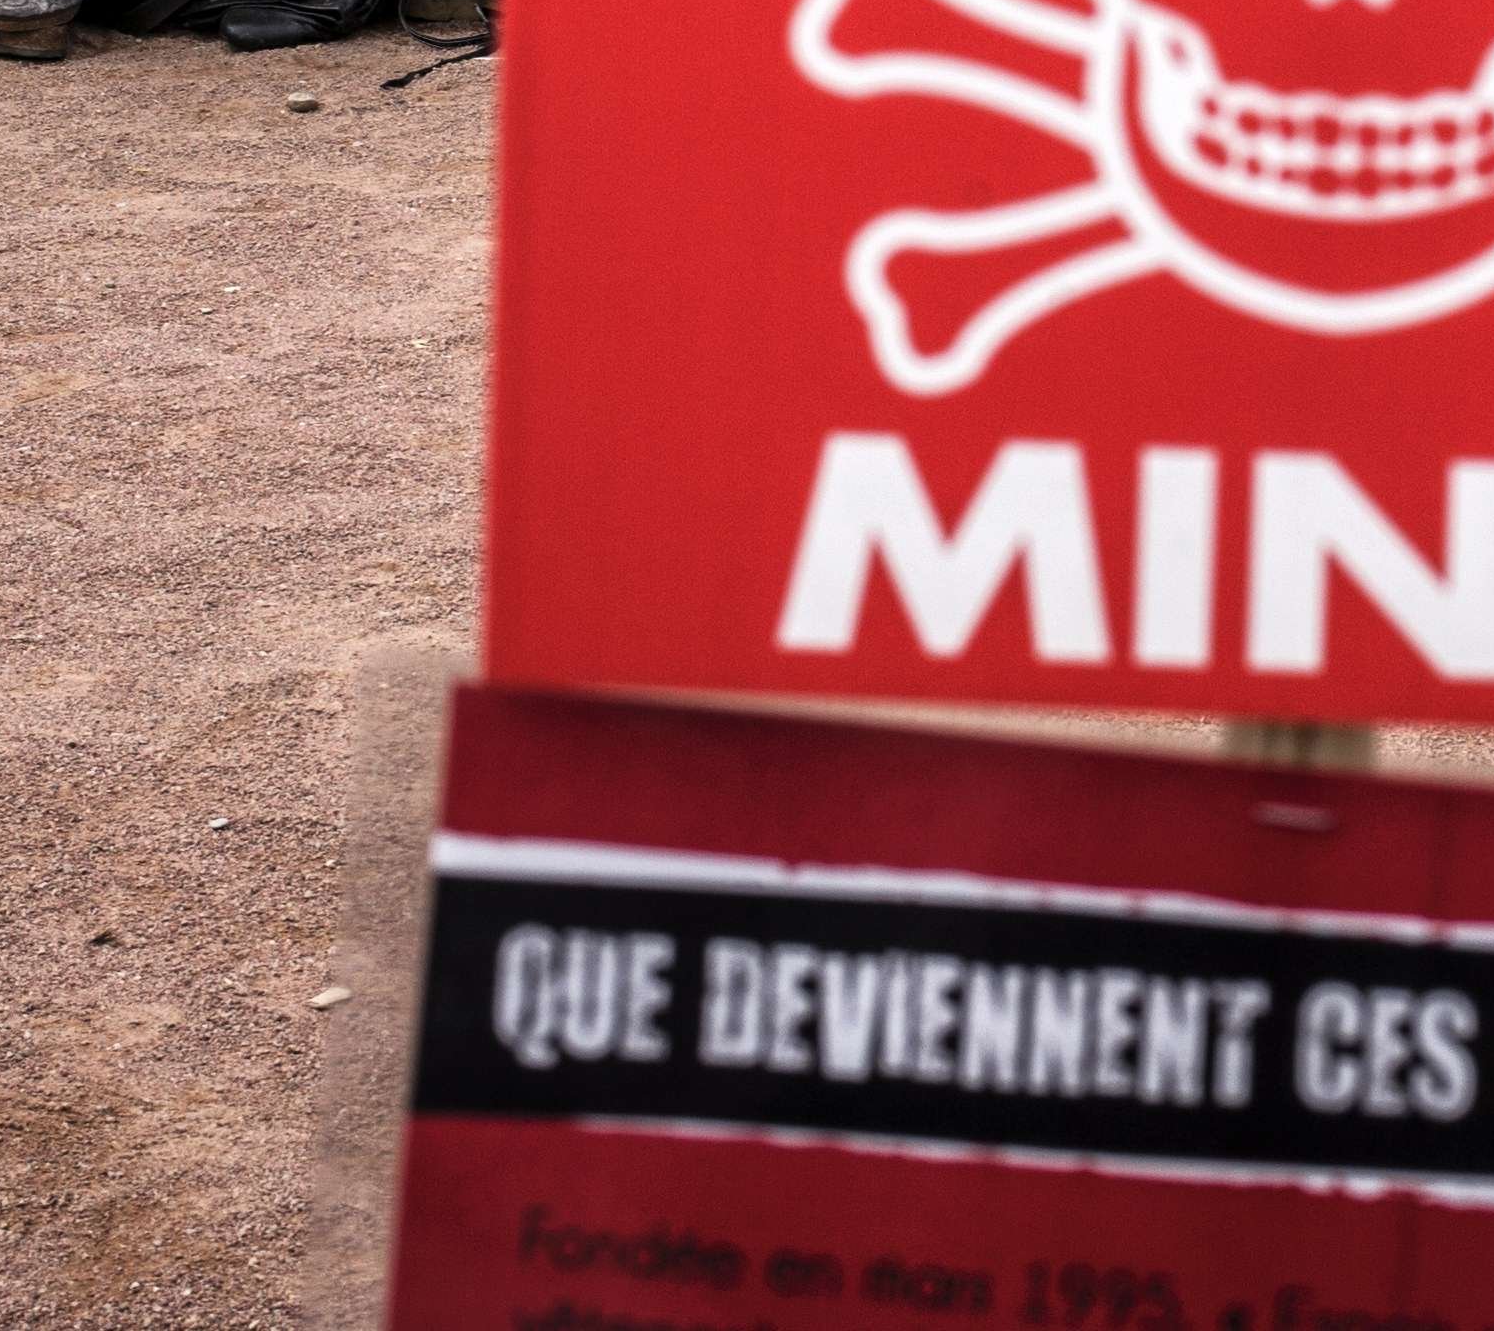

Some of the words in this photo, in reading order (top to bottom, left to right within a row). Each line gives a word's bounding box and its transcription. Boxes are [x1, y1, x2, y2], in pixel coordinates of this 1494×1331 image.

[495, 925, 673, 1068] QUE
[700, 946, 1268, 1107] DEVIENNENT
[1297, 984, 1476, 1118] CES
[763, 1247, 846, 1300] en
